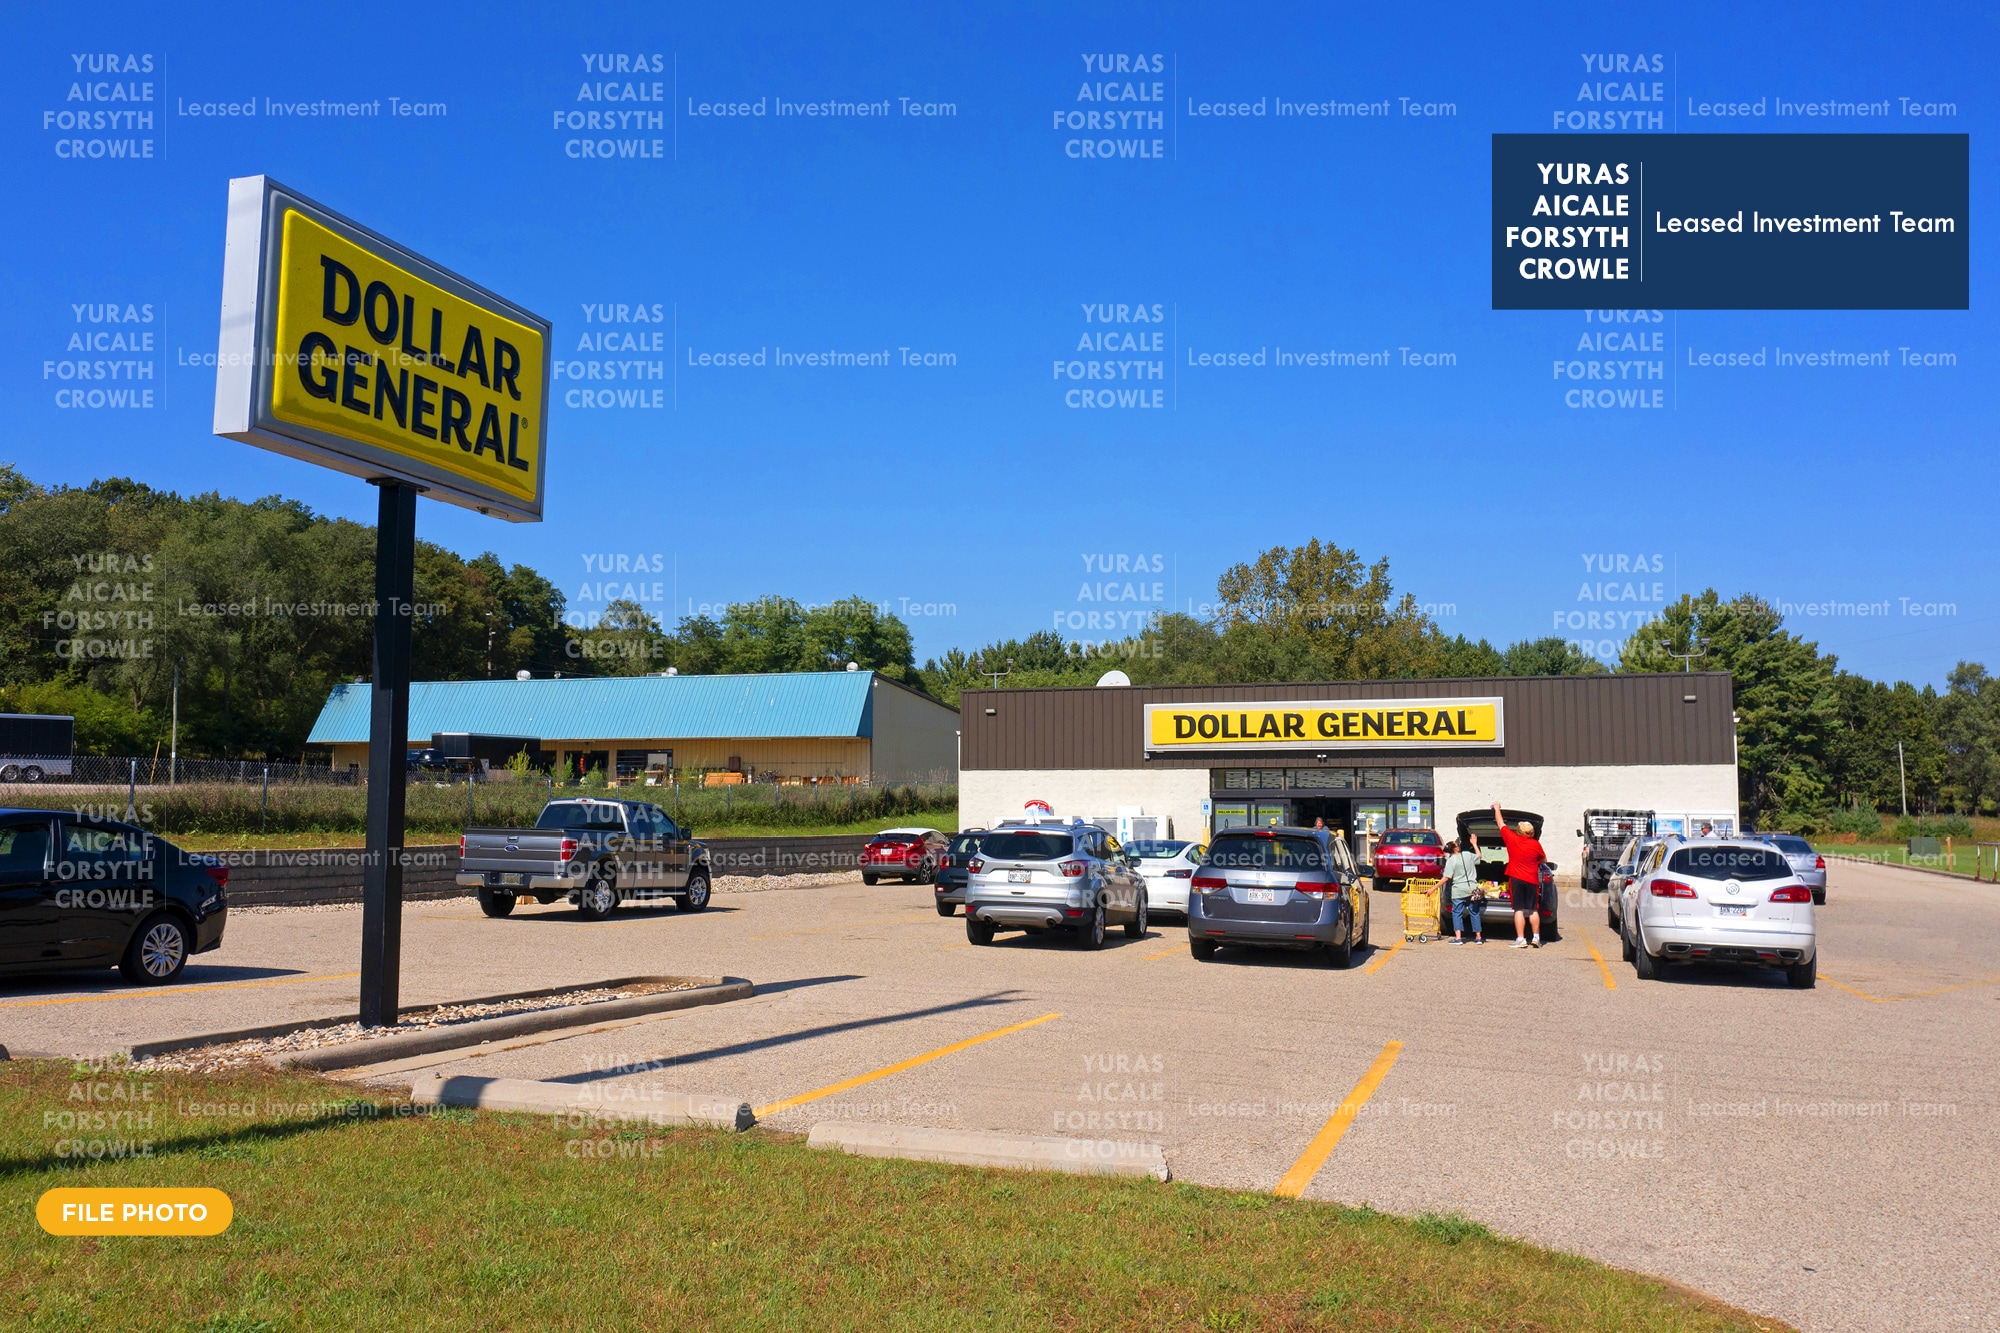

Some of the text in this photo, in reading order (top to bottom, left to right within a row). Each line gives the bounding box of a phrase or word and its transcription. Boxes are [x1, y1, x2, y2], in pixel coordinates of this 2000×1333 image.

[320, 253, 522, 401] DOLLAR
[1173, 709, 1477, 739] DOLLAR GENERAL
[1402, 790, 1416, 798] 546
